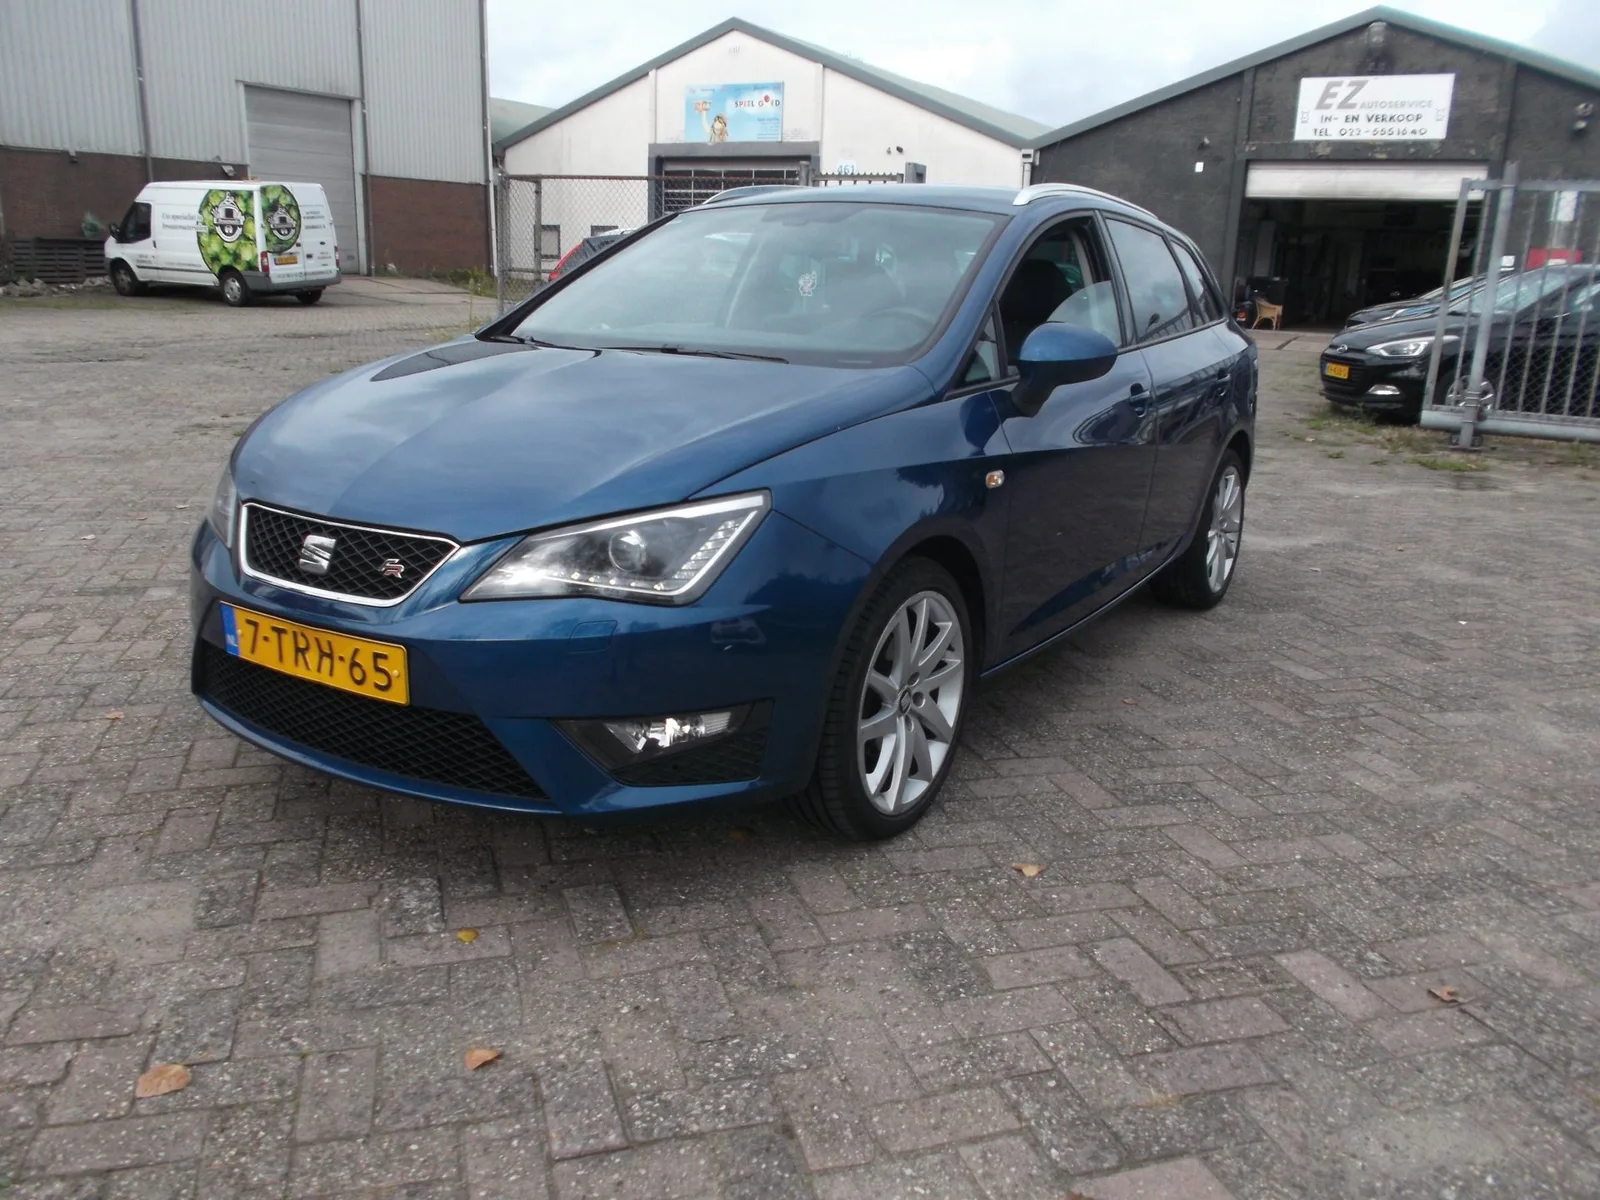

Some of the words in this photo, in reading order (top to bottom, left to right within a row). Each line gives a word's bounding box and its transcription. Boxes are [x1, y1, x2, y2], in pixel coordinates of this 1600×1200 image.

[1315, 80, 1368, 110] EZ
[1359, 100, 1433, 109] AUTOSERVICE
[1345, 114, 1360, 123] EN
[1366, 113, 1424, 123] VERKOOP
[245, 618, 392, 691] 7-TRH-65
